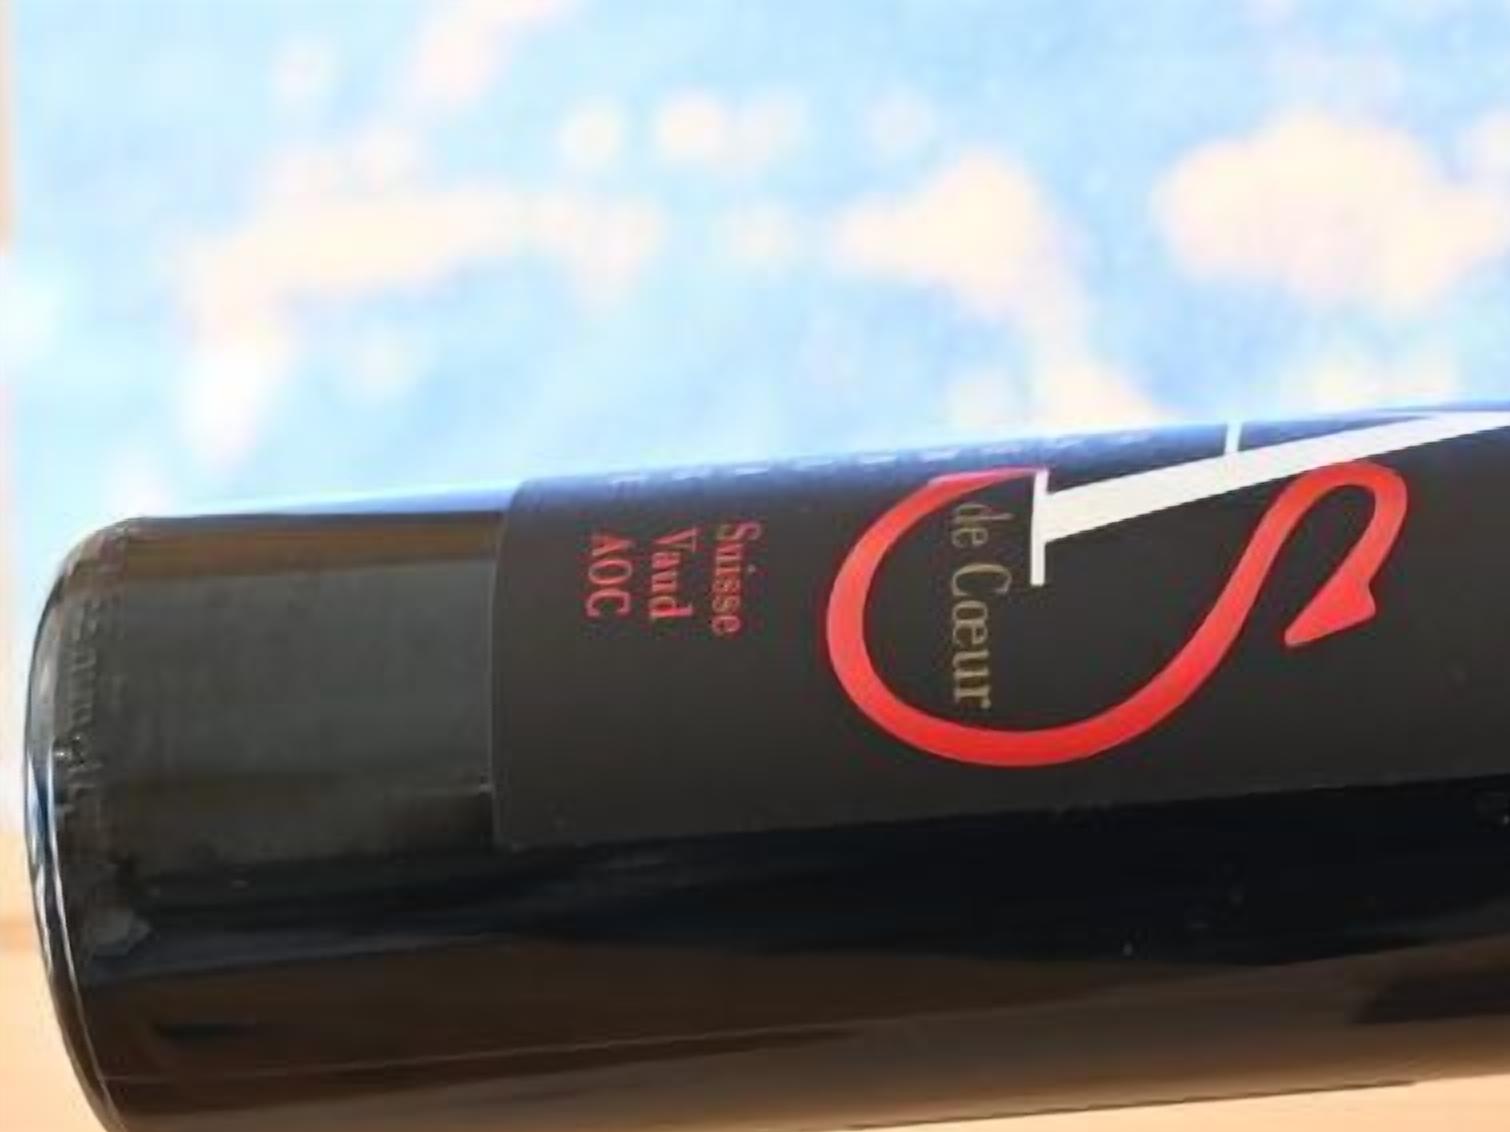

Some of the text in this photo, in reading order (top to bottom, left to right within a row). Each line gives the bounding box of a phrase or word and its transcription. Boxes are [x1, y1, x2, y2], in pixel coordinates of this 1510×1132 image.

[585, 533, 635, 620] AOC
[648, 527, 698, 622] Vaud
[712, 521, 762, 636] Suisse
[950, 501, 1013, 711] de Cœur
